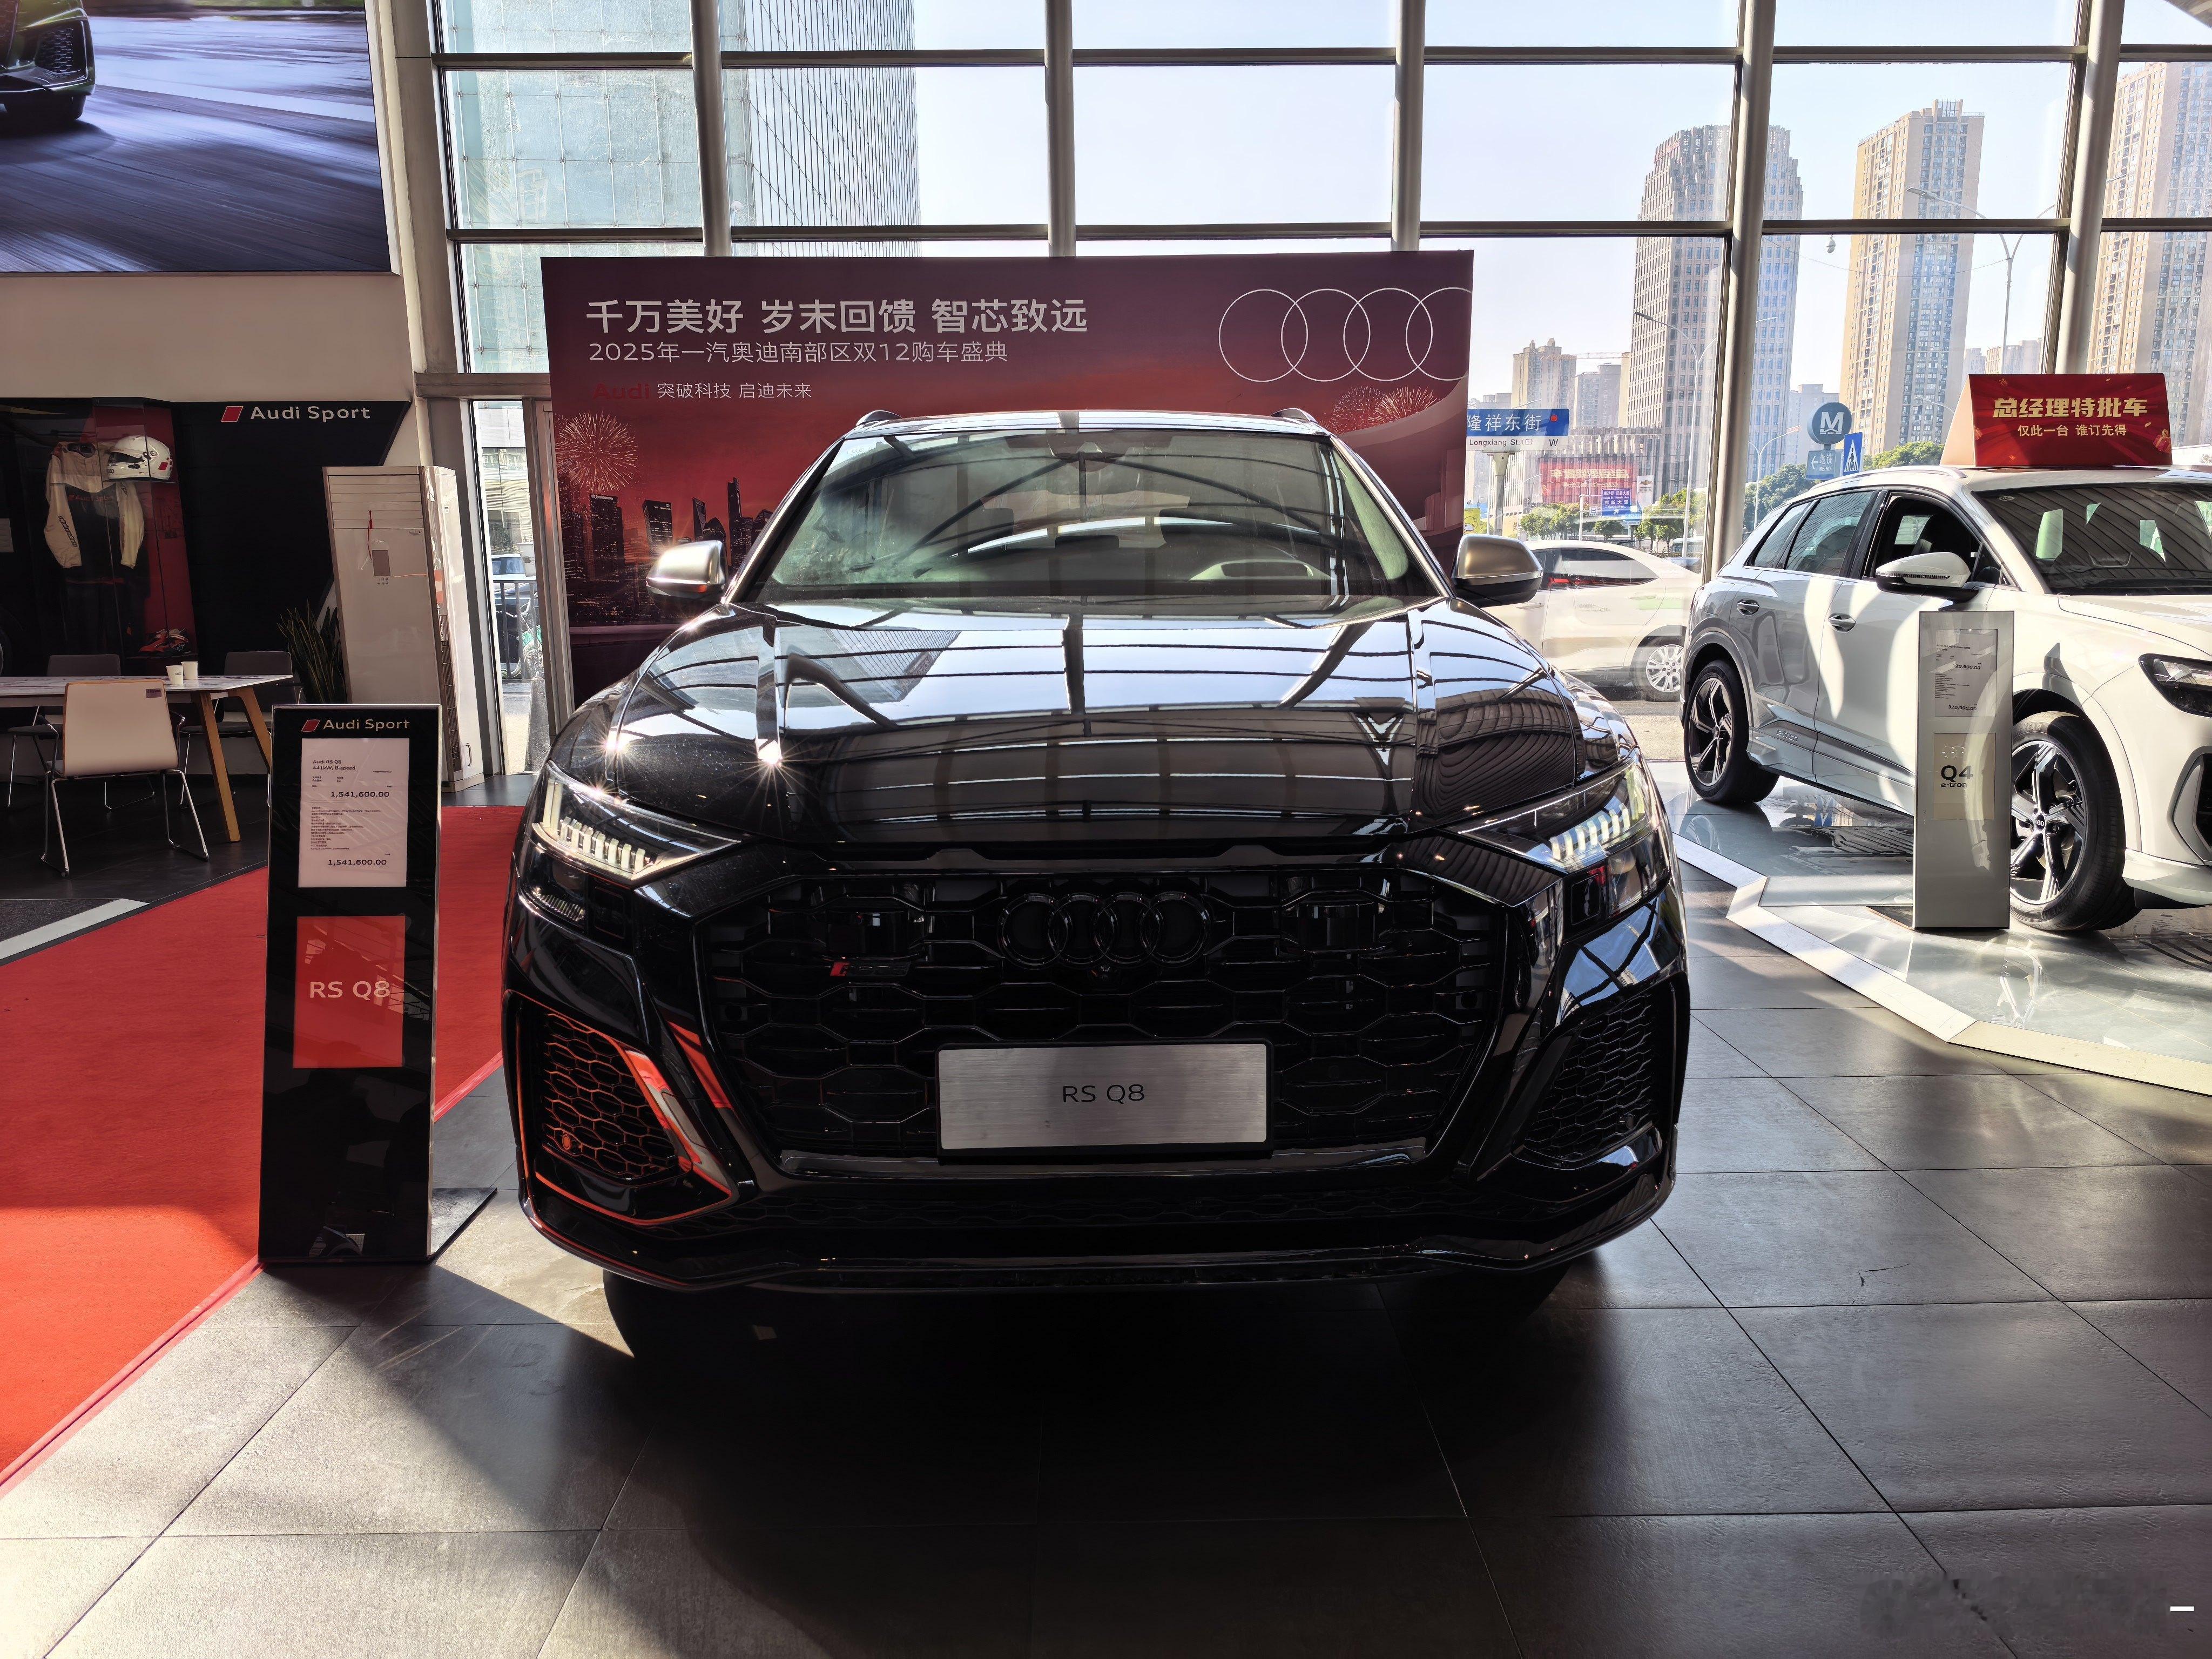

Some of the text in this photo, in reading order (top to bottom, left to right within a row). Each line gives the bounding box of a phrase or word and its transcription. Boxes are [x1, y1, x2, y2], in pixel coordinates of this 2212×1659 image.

[586, 299, 1088, 333] 千万美好 岁末回馈 智芯致远
[589, 341, 1008, 362] 2025年一汽奥迪南部区双12购车盛典
[593, 383, 650, 400] Audi
[657, 382, 812, 399] 突破科技 启迪未来
[250, 406, 370, 423] Audi Sport
[1993, 397, 2148, 418] 总经理特批车
[1467, 414, 1541, 431] 隆祥东街
[2018, 424, 2127, 437] 仅此一台 谁订先得
[1469, 439, 1507, 447] Longxiang
[1819, 453, 1832, 464] 地铁
[323, 719, 410, 731] Audi Sport
[1940, 765, 1973, 783] Q4
[309, 981, 390, 1001] RS Q8
[1063, 1084, 1145, 1104] RS Q8
